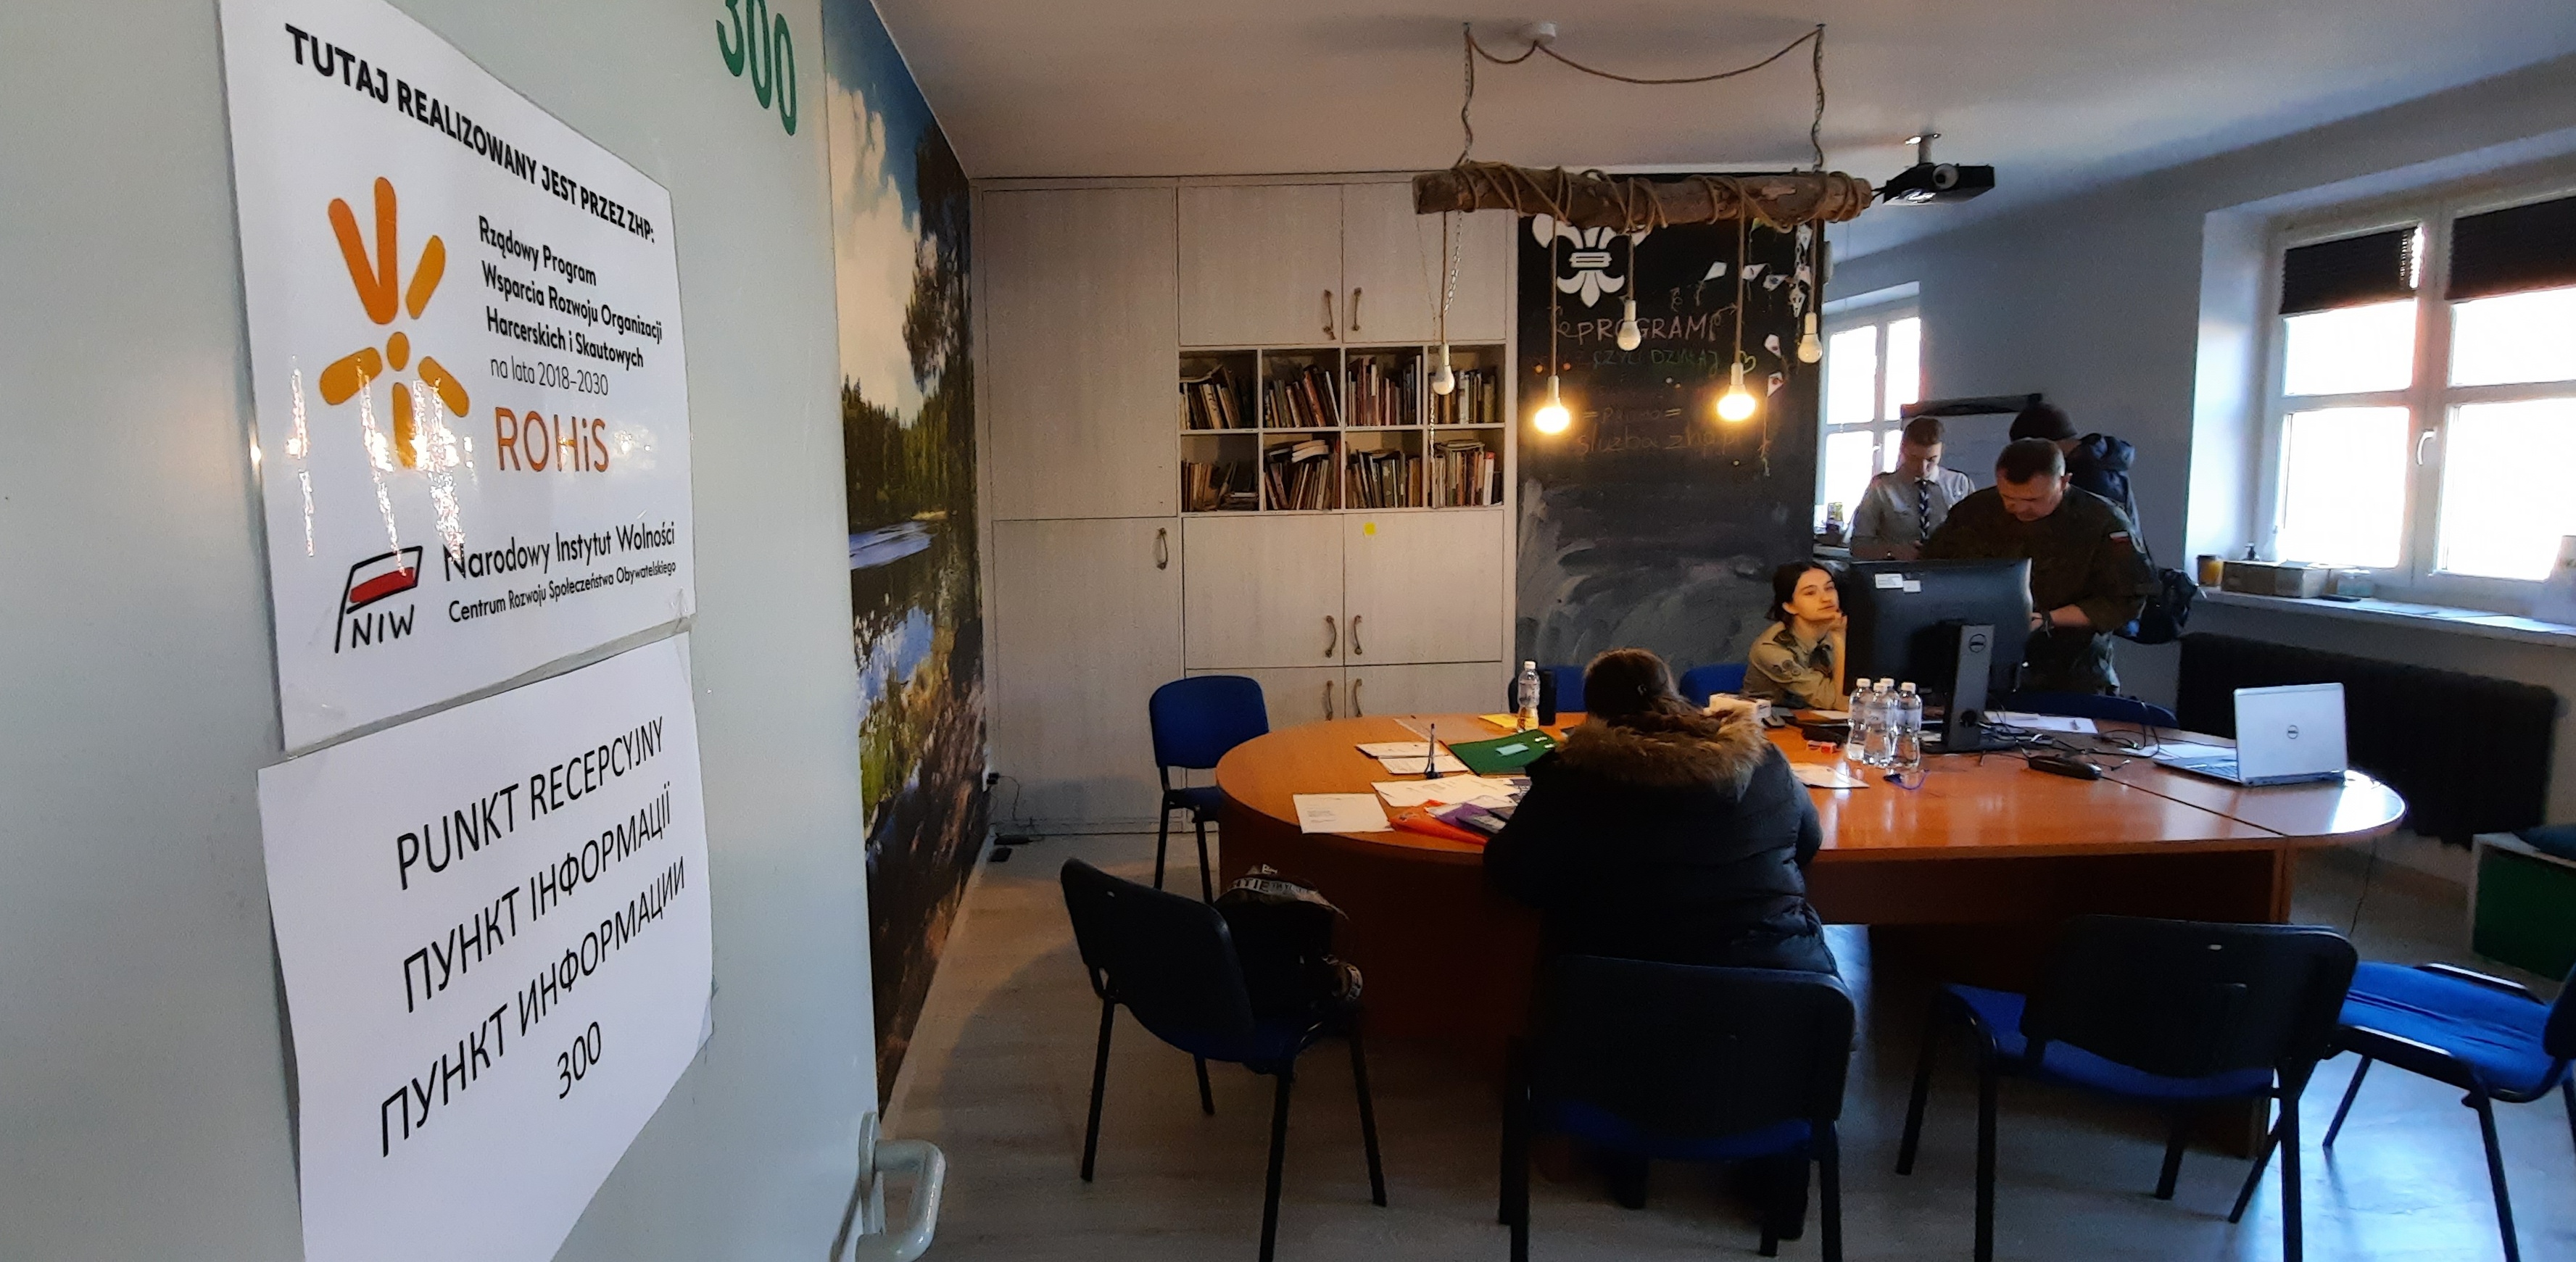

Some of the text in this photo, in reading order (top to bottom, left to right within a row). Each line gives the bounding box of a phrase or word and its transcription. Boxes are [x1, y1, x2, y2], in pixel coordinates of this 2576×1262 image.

[285, 22, 655, 244] TUTAJ REALIZOWANY JEST PRZEZ ZHP:
[479, 215, 596, 286] Rządowy Program
[481, 260, 662, 344] Wsparcia Rozwoju Organizacji
[486, 306, 644, 371] Harcerskich i Skautowych
[490, 359, 508, 379] na
[511, 355, 535, 384] lata
[494, 407, 609, 473] ROHiS
[443, 521, 675, 581] Narodowy Instytut Wolności
[351, 605, 415, 649] NIW
[448, 560, 676, 623] Centrum Rozwoju Społeczeństwa Obywatelskiego
[397, 715, 663, 891] PUNKT RECEPCYJNY
[404, 781, 671, 1013] ПУНКТ ІНФОРМАЦІЇ
[381, 855, 685, 1158] ПУНКТ ИНФОРМАЦИИ
[558, 1021, 601, 1100] 300
